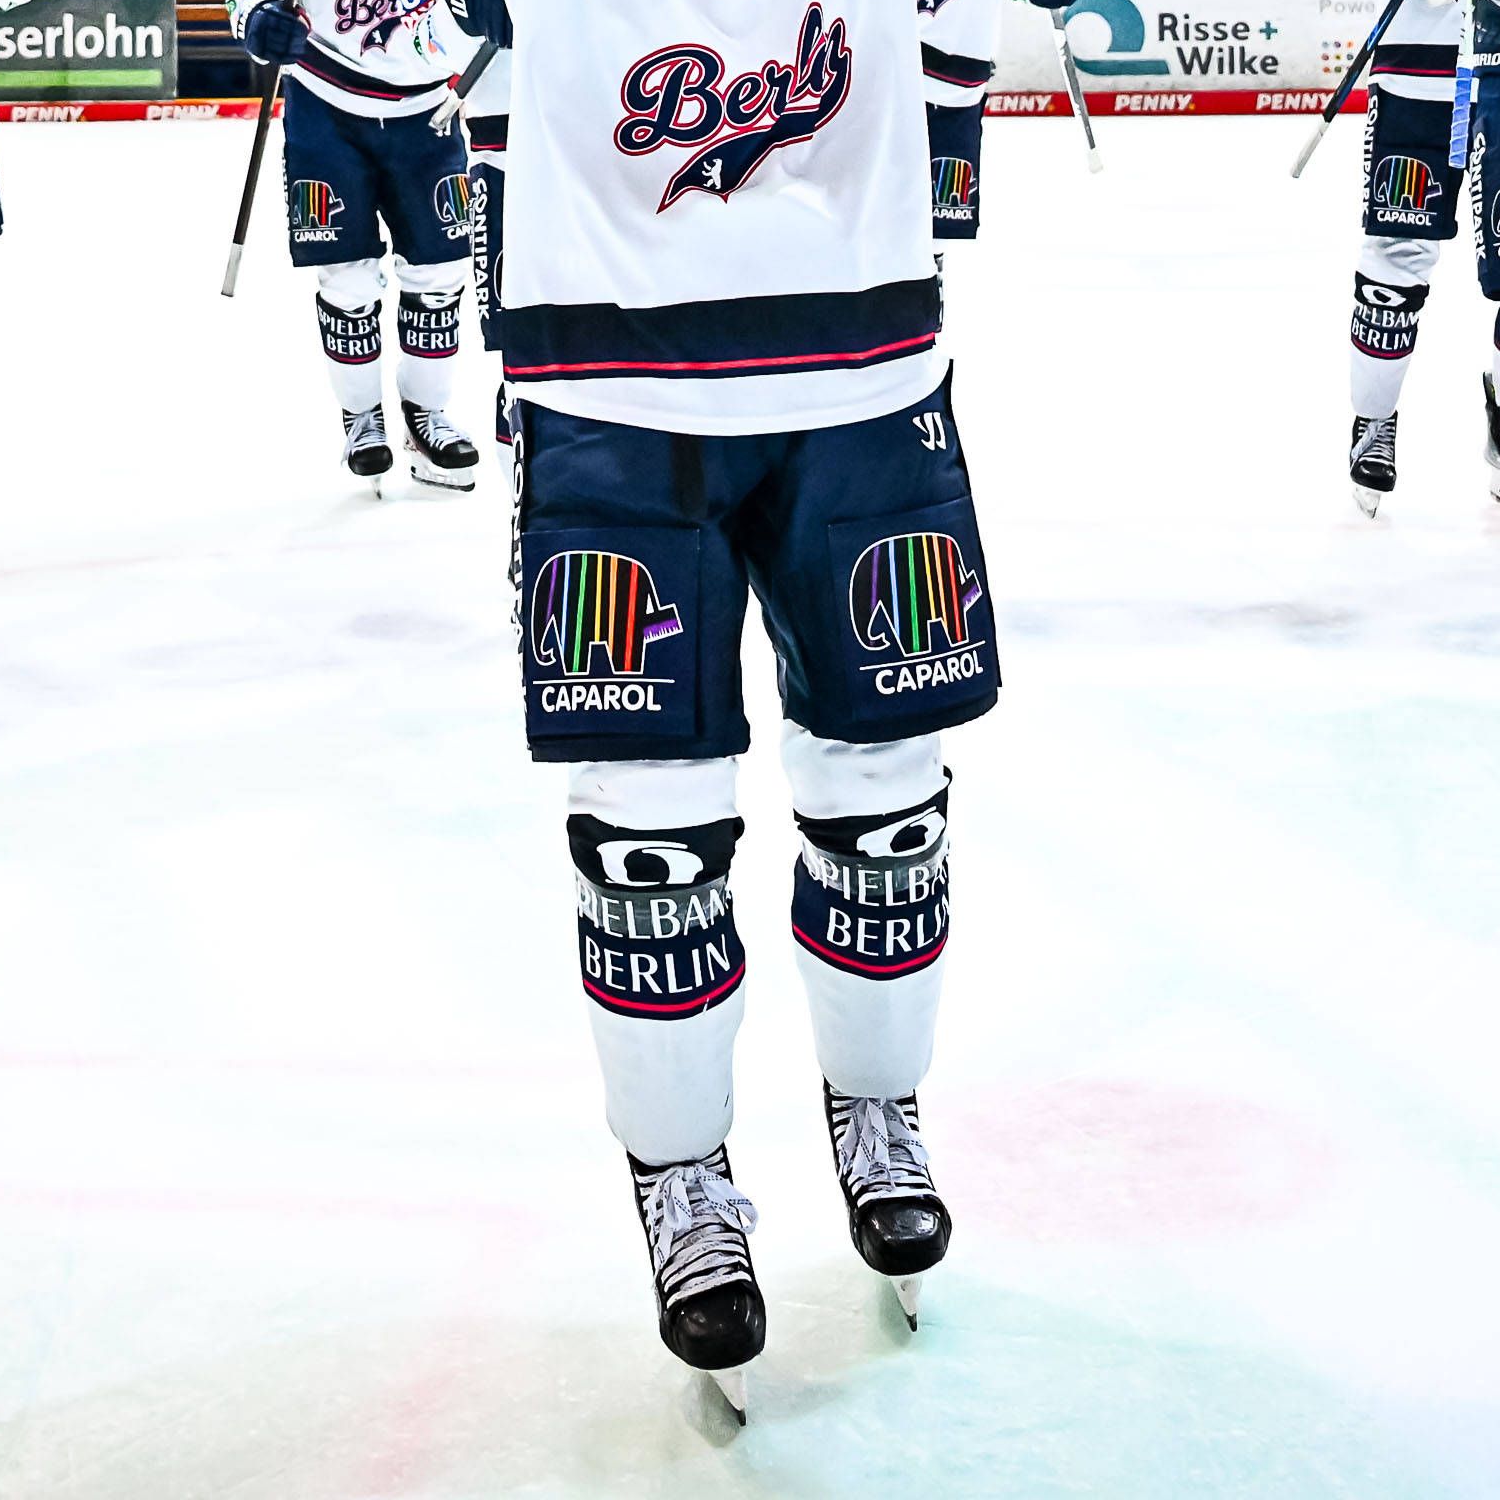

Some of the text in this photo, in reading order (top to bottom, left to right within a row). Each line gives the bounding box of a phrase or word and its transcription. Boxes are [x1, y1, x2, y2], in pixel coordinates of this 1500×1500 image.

[1157, 12, 1251, 43] Risse
[1175, 47, 1279, 76] Wilke
[932, 207, 974, 222] APAROL
[1377, 209, 1432, 226] CAPAROL
[293, 229, 339, 242] CAPAROL
[875, 648, 984, 697] CAPAROL
[540, 684, 662, 713] CAPAROL
[584, 933, 732, 996] BERLIN
